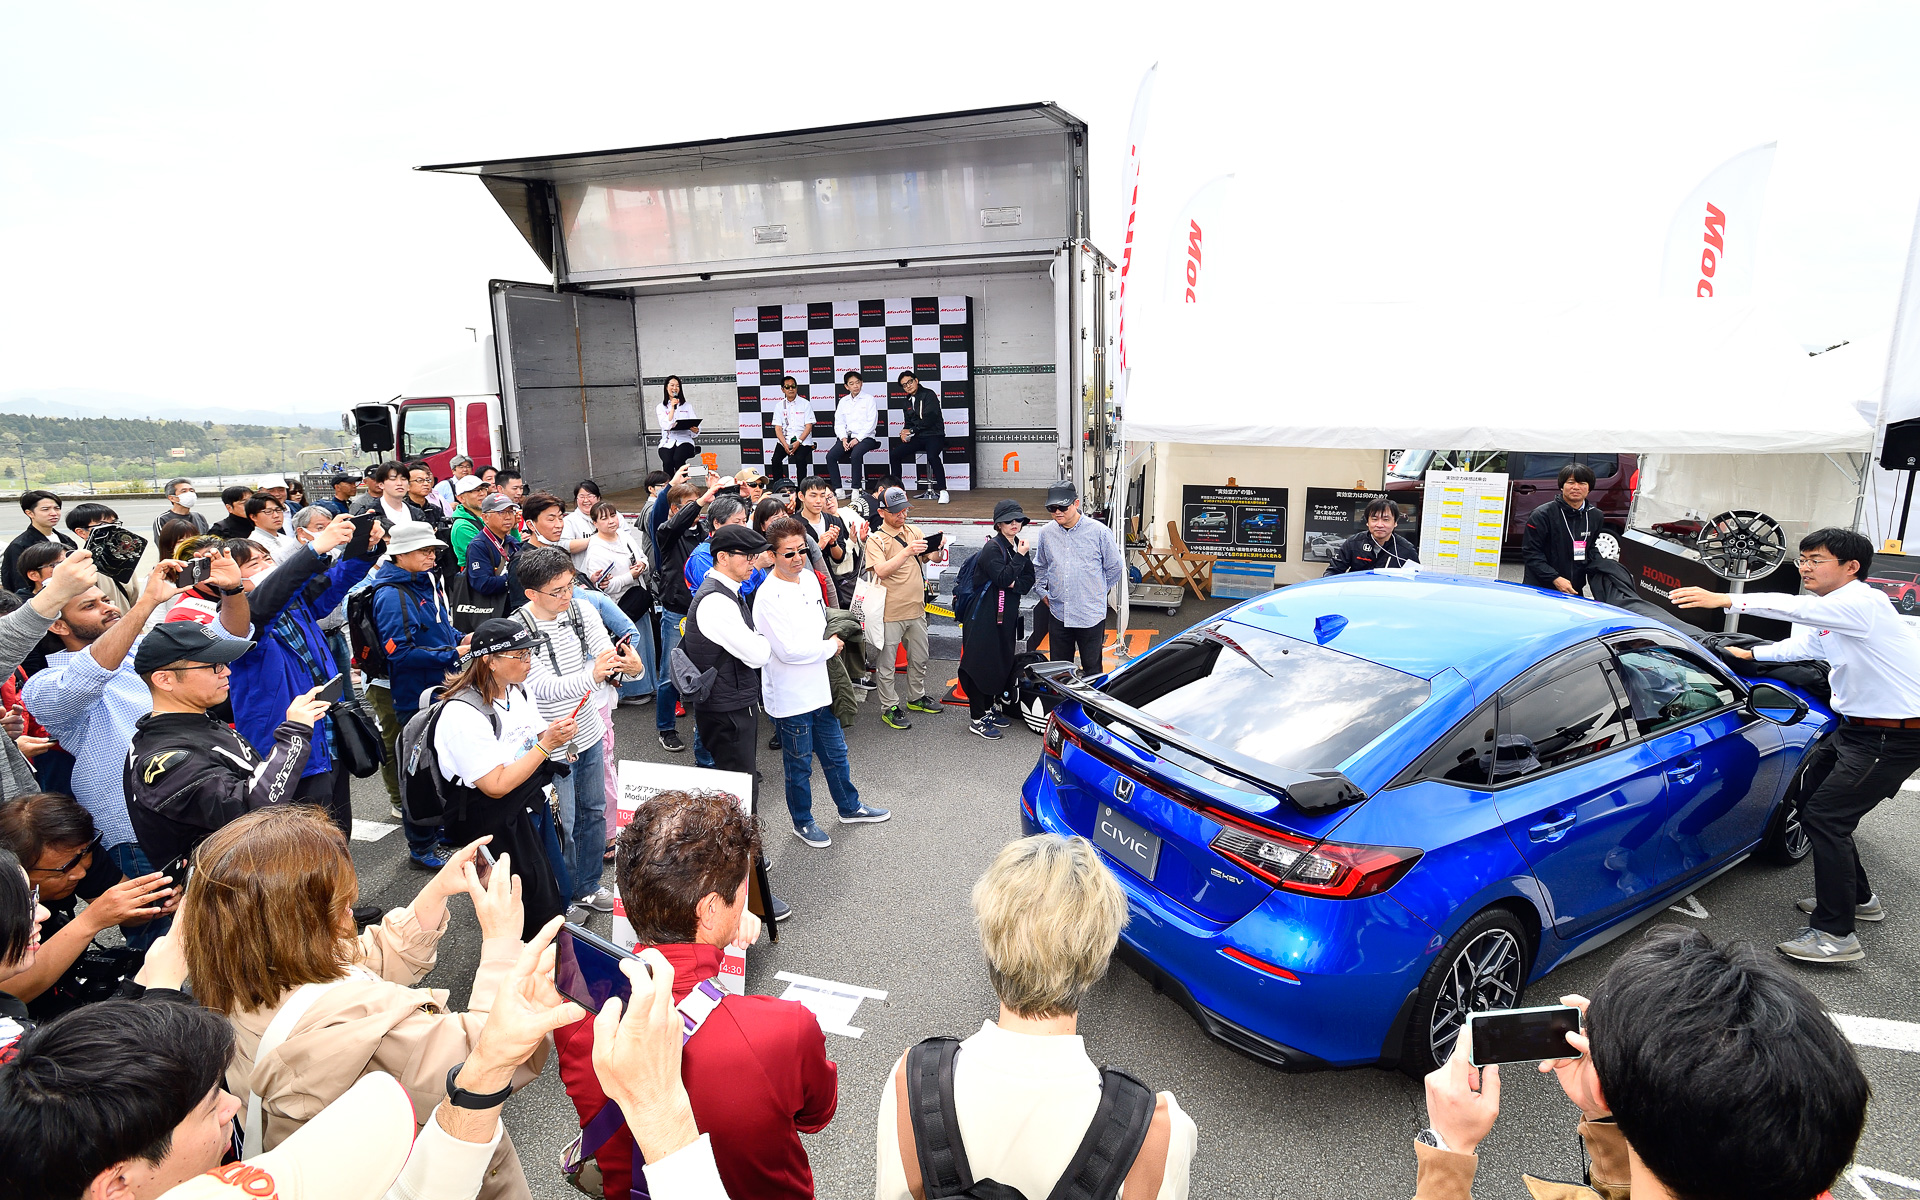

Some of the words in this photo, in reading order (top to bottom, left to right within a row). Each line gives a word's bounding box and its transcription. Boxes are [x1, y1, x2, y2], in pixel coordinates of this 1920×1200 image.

[1640, 580, 1653, 592] Honda
[1642, 565, 1681, 588] HONDA
[1101, 820, 1148, 860] CIVIC
